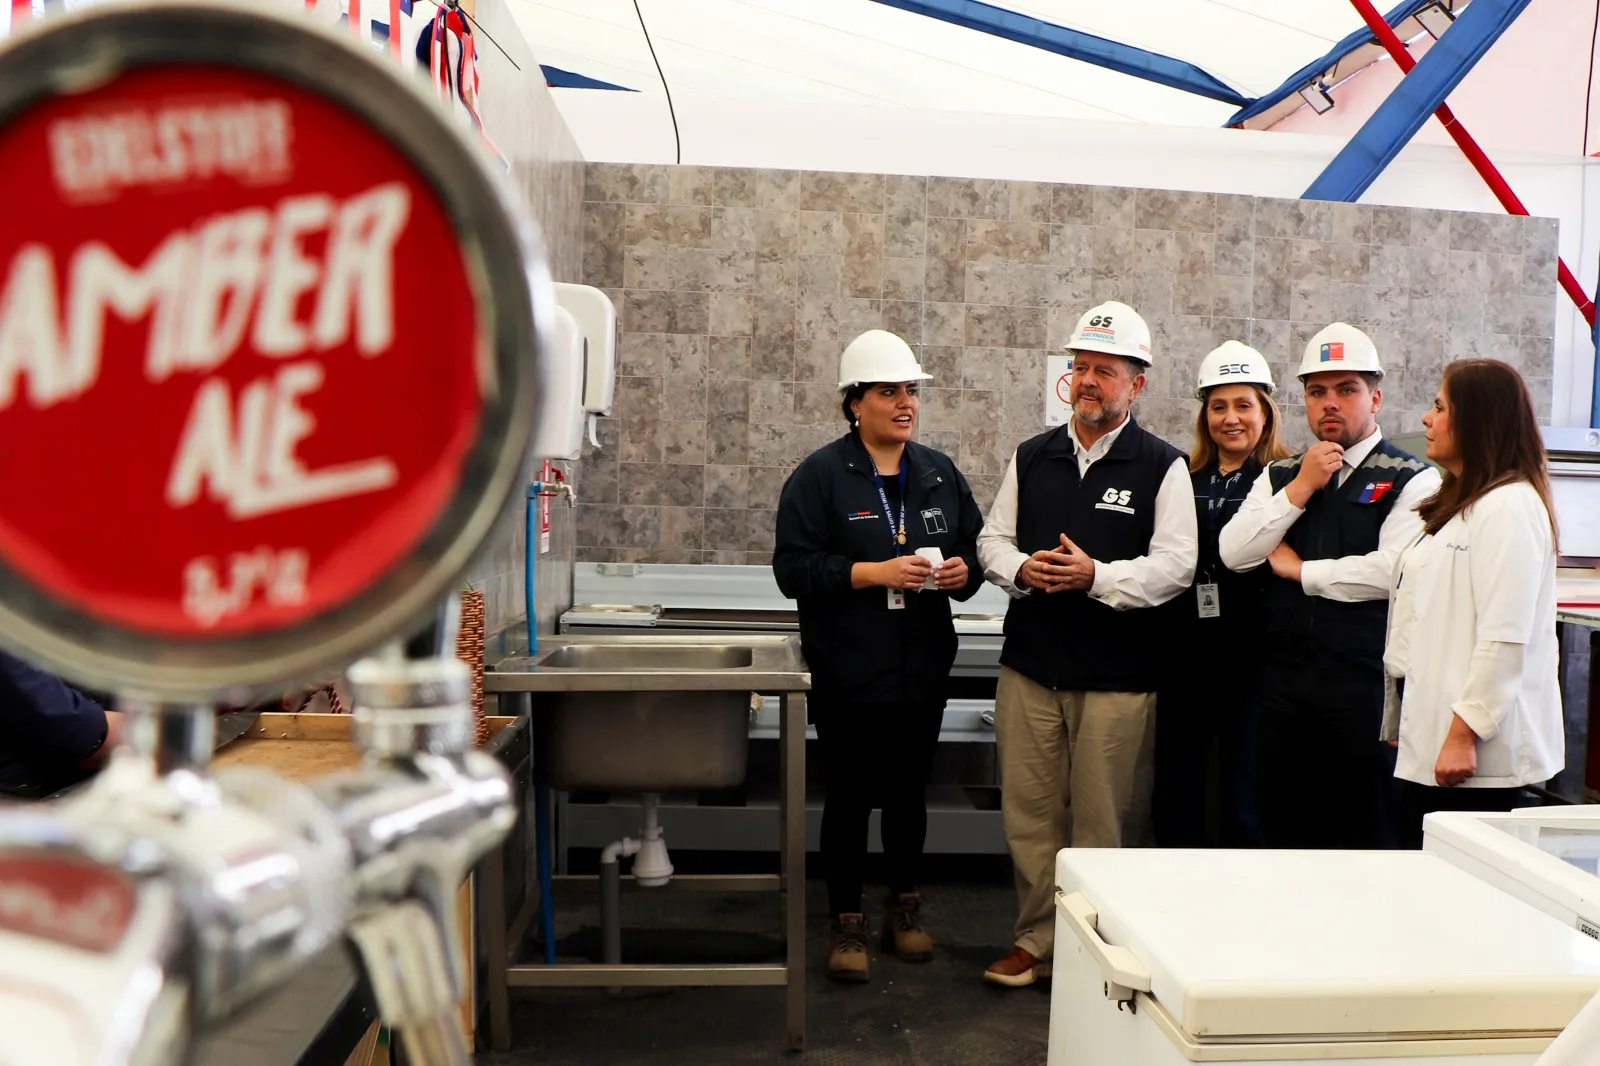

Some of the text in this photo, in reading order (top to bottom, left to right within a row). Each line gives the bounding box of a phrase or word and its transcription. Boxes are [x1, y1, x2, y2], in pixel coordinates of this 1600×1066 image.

[0, 183, 411, 408] AMBER
[1089, 315, 1113, 328] GS
[1219, 363, 1250, 376] SEC
[166, 361, 397, 519] ALE
[1102, 487, 1132, 506] GS
